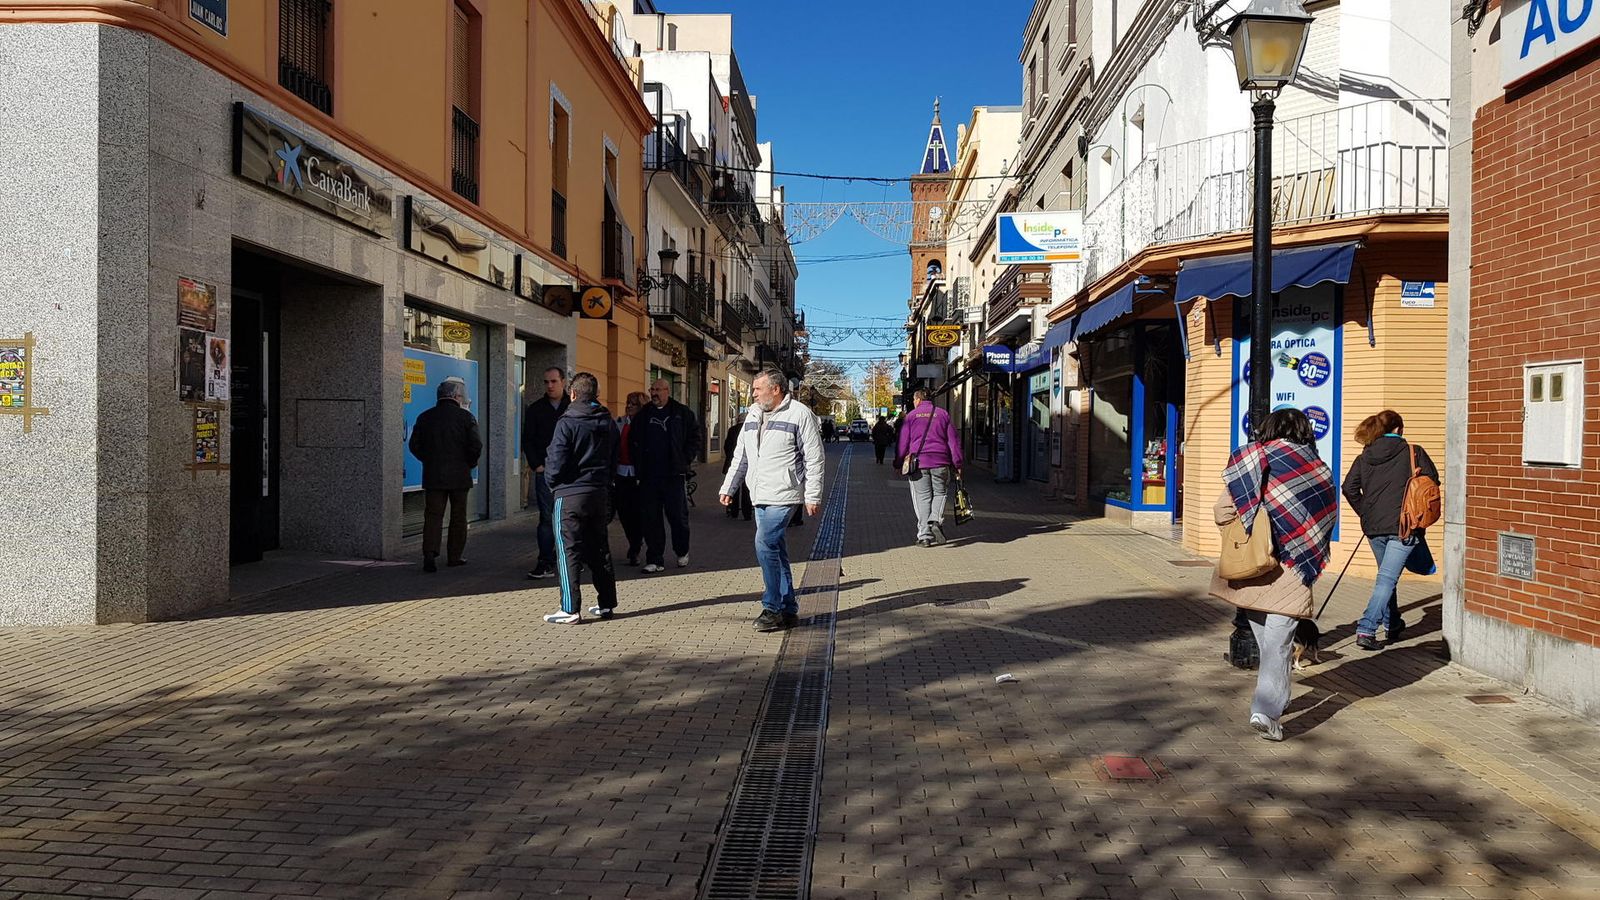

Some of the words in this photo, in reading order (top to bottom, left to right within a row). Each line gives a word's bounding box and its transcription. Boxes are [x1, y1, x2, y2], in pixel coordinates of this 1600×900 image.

[307, 156, 371, 211] CaixaBank
[1054, 228, 1067, 237] pc
[1272, 304, 1311, 318] nside
[1312, 311, 1329, 323] pc
[1285, 337, 1315, 349] ÓPTICA
[1300, 363, 1317, 379] 30
[1276, 392, 1295, 401] WIFI
